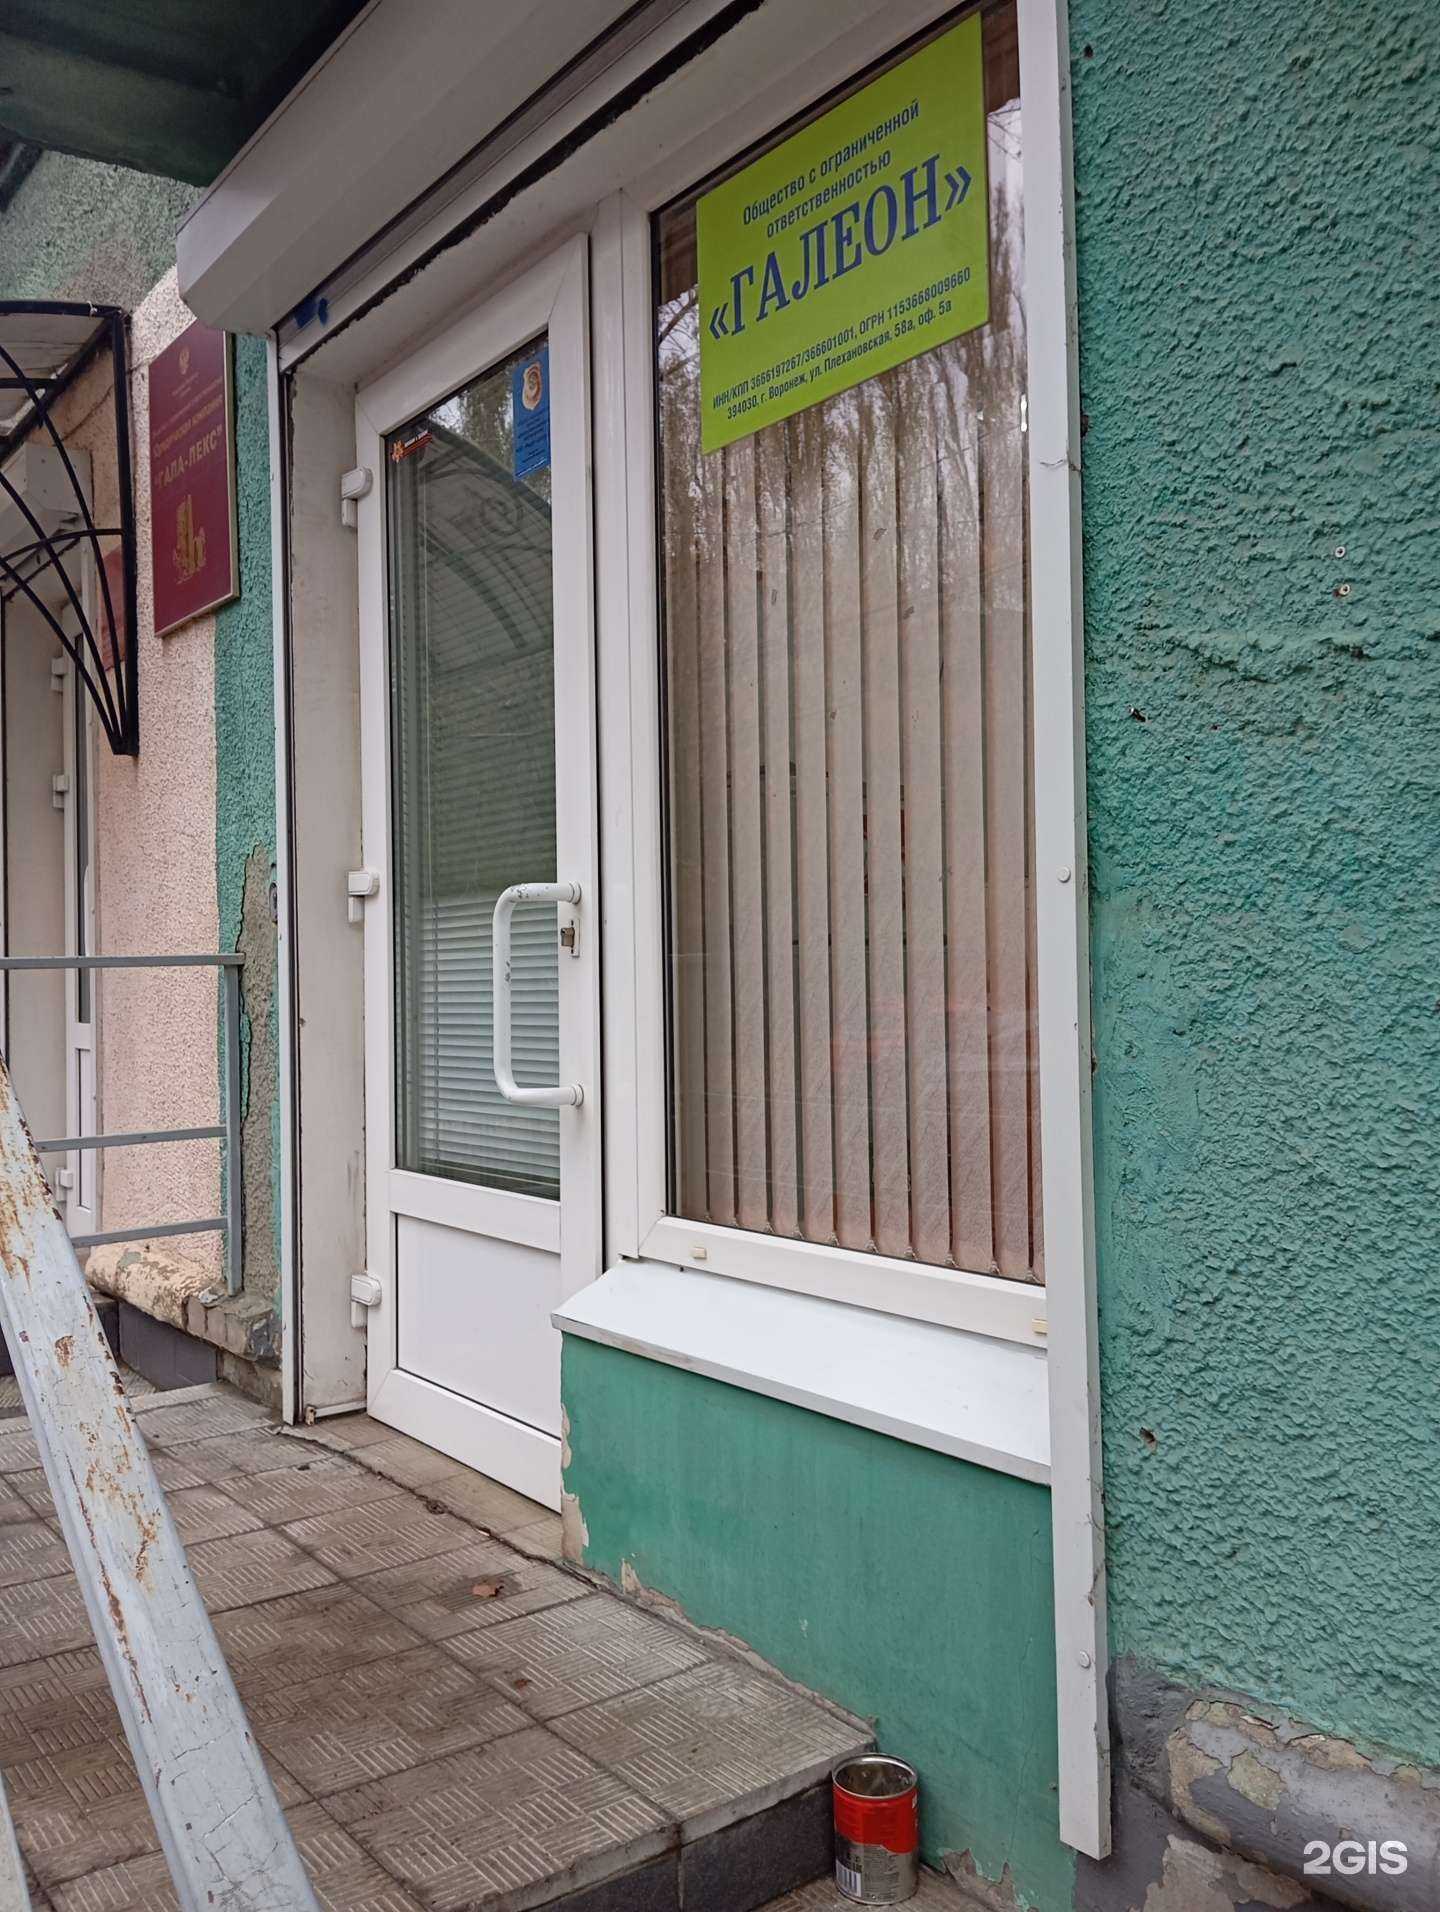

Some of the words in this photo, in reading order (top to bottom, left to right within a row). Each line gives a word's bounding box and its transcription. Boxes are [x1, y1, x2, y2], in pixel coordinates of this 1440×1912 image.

[743, 176, 805, 225] Общество
[809, 168, 816, 184] с
[820, 98, 920, 176] ограниченной
[767, 150, 891, 238] ответственностью
[709, 154, 973, 341] «ГАЛЕОН»
[713, 381, 749, 408] ИНН/КПП
[860, 310, 884, 334] ОГРН
[888, 267, 971, 320] 1153668009660
[727, 394, 759, 419] 394030,
[769, 374, 808, 400] Воронеж,
[810, 366, 822, 383] ул.
[825, 328, 892, 372] Плехановская,
[918, 307, 936, 325] оф.
[938, 300, 952, 315] 5а
